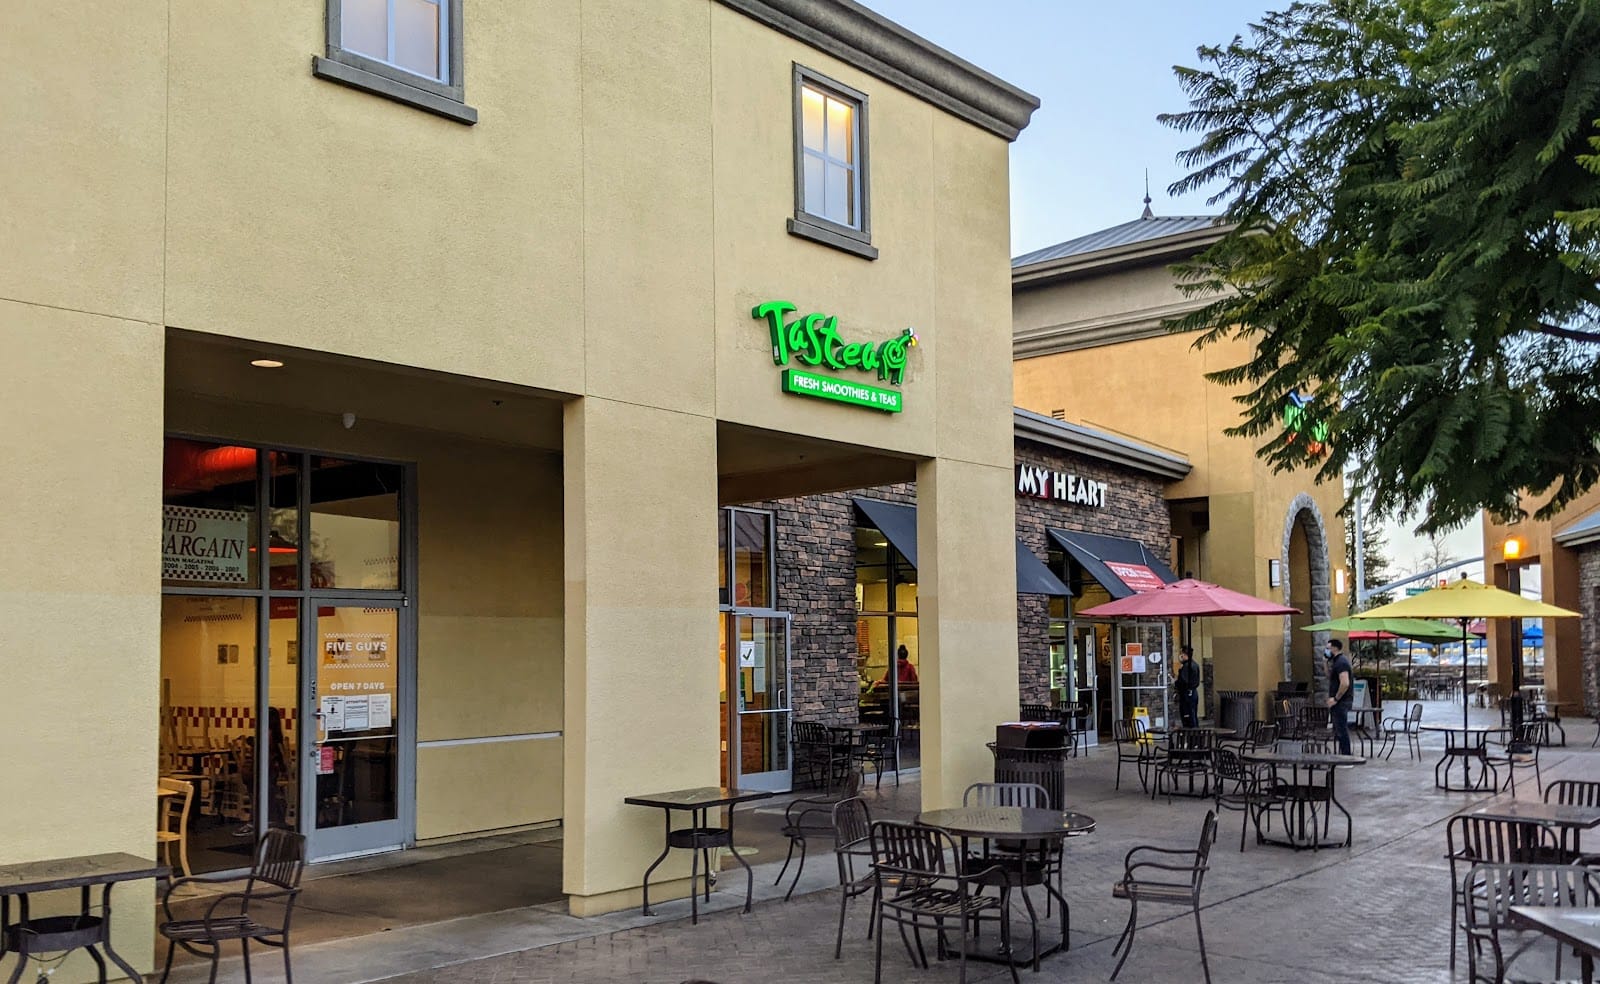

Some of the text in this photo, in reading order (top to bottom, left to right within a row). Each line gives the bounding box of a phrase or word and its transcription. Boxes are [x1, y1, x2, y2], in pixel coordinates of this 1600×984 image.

[793, 375, 897, 406] FRESH SMOOTHIES & TEAS
[1018, 464, 1108, 508] MY HEART
[162, 517, 197, 533] TED
[162, 534, 244, 559] ARGAIN
[326, 641, 388, 651] FIVE GUYS
[330, 682, 385, 691] OPEN 7 DAYS
